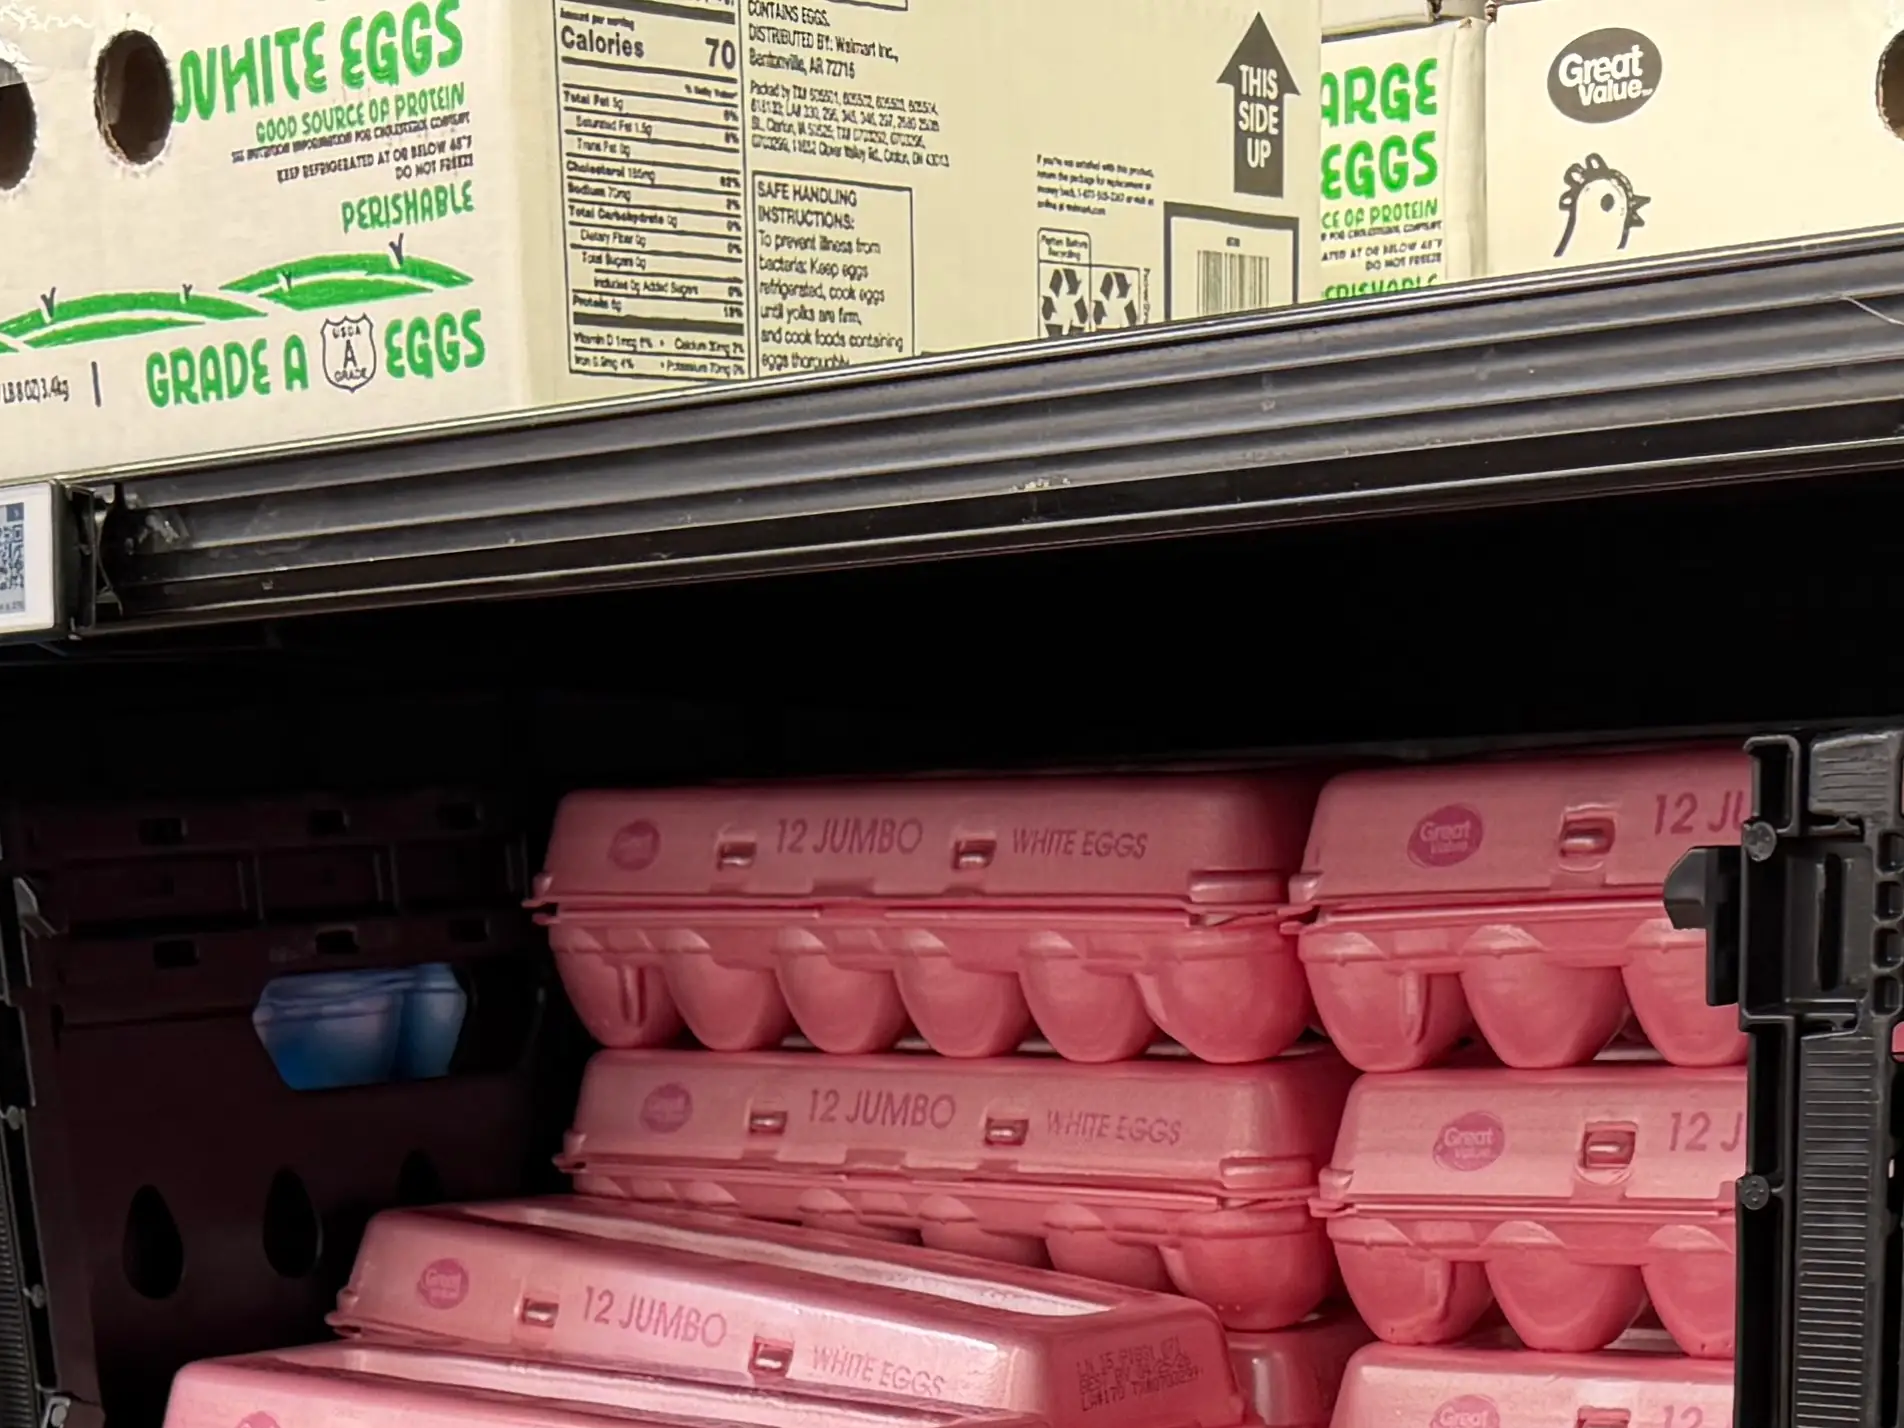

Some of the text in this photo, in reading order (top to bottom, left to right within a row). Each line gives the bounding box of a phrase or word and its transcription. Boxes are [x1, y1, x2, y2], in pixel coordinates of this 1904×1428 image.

[560, 25, 736, 69] Calories 70
[749, 23, 813, 49] DISTRIBUTED
[835, 36, 875, 57] Walmart
[175, 0, 463, 122] WHITE EGGS
[1557, 44, 1644, 89] Great
[1238, 64, 1278, 100] THIS
[1321, 57, 1437, 127] ARGE
[1578, 76, 1642, 107] Value
[256, 82, 465, 143] GOOD SOURCE OF PROTEIN
[1238, 101, 1279, 135] SIDE
[302, 154, 375, 179] REFRIGERATED
[377, 151, 390, 166] AT
[410, 142, 446, 160] BELOW
[395, 153, 473, 179] DO NOT FREEZE
[1247, 138, 1272, 168] UP
[1321, 131, 1438, 200] EGGS
[341, 179, 474, 233] PERISHABLE
[758, 181, 857, 207] SAFE HANDLING
[758, 206, 855, 230] INSTRUCTIONS:
[146, 308, 487, 407] GRADE A EGGS
[343, 339, 357, 369] A
[776, 818, 1147, 859] 12 JUMBO WHITE EGGS
